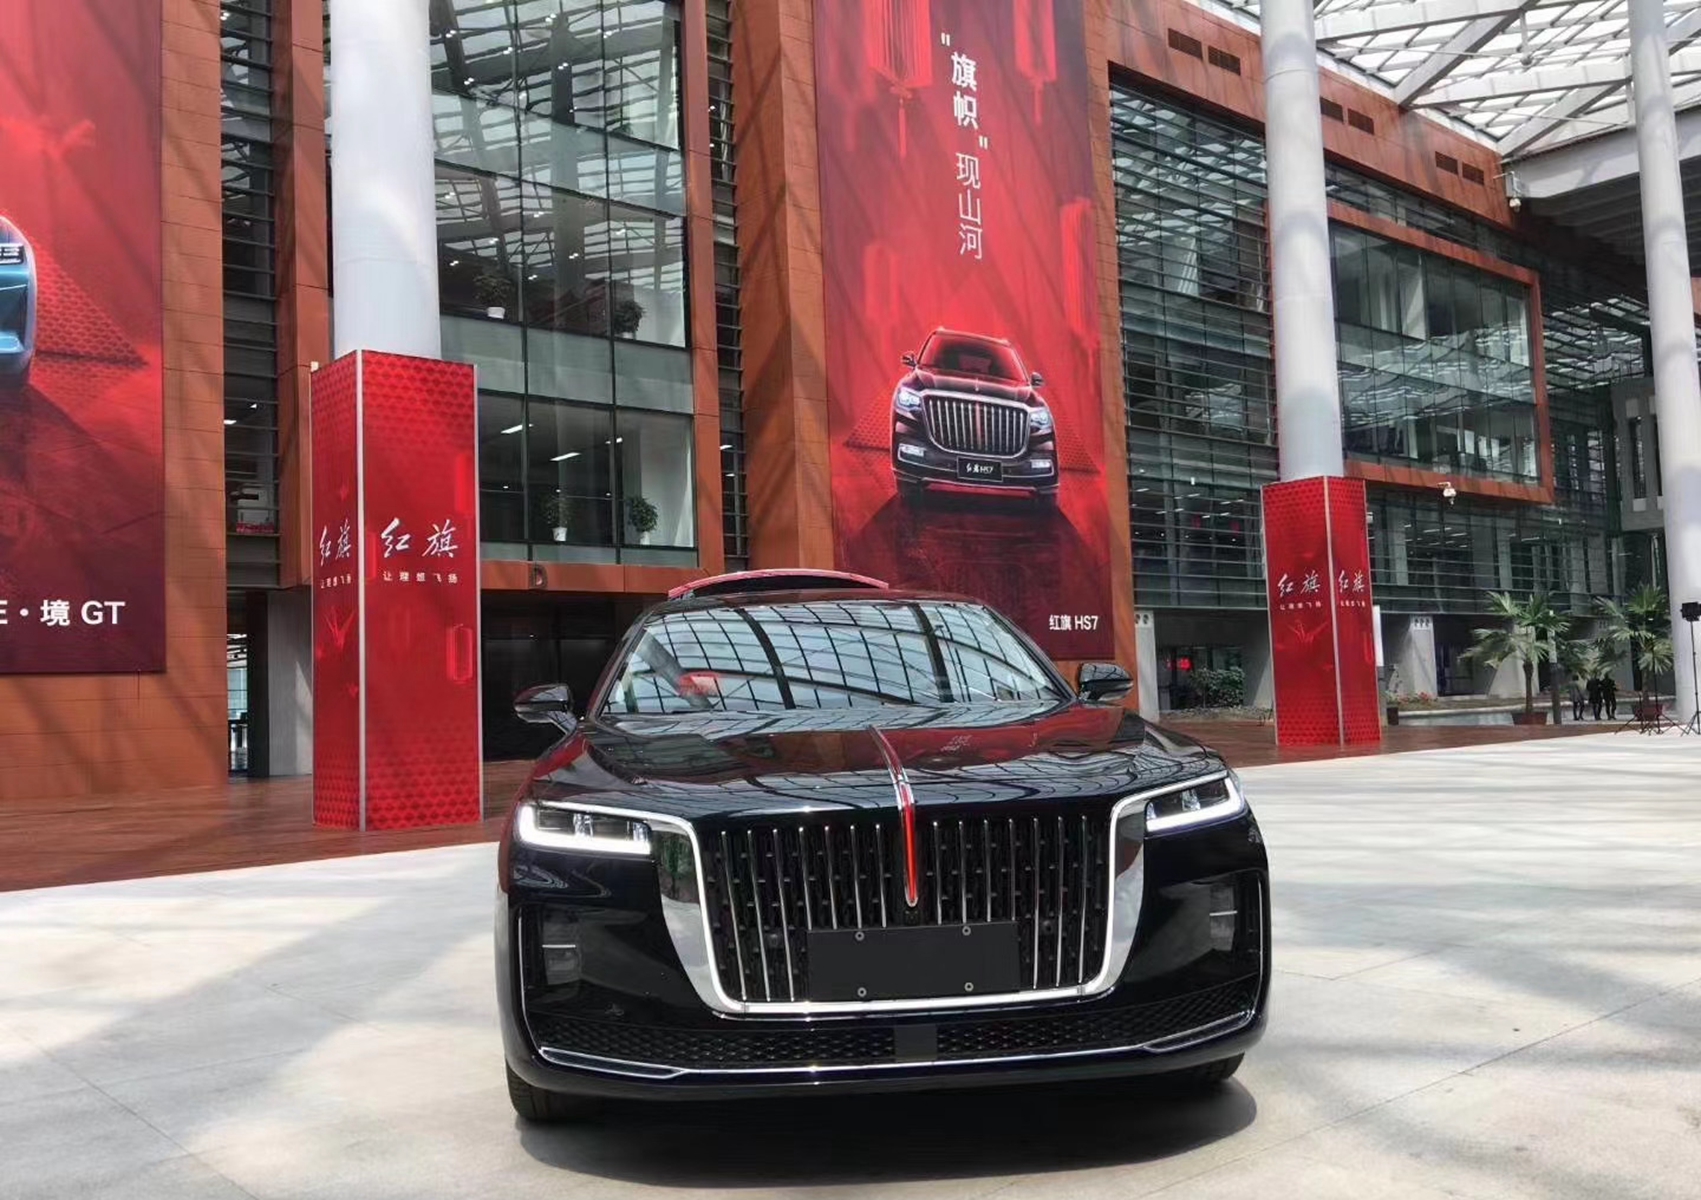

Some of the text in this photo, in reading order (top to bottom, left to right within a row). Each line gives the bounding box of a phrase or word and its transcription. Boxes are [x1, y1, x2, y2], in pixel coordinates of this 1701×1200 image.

[319, 518, 352, 566] 红旗
[381, 517, 459, 558] 红旗
[1277, 569, 1321, 598] 红旗
[81, 600, 126, 625] GT
[1049, 614, 1099, 631] 红旗 HS7
